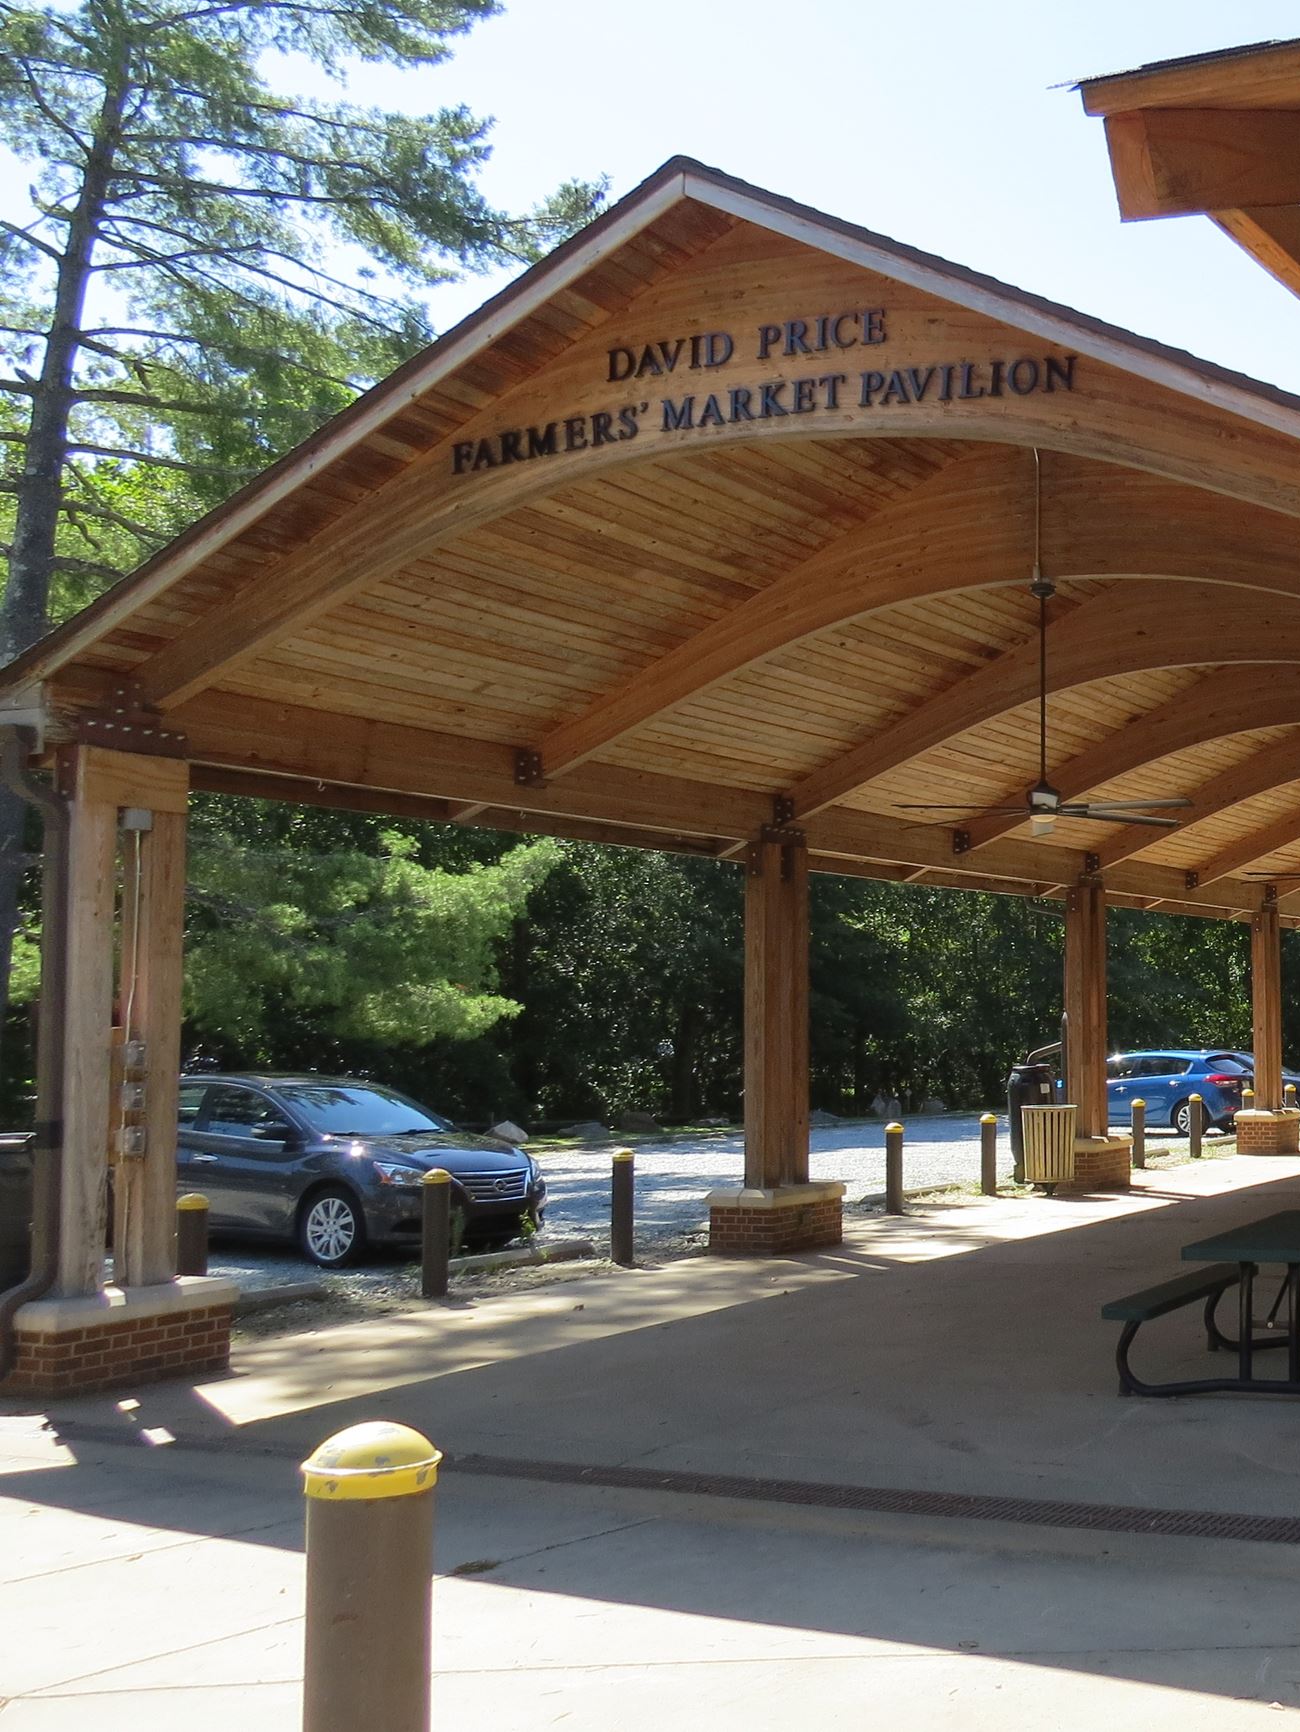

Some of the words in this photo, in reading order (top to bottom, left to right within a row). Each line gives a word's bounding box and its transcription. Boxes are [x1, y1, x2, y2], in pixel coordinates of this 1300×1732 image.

[606, 331, 734, 383] DAVID
[756, 308, 887, 359] PRICE
[451, 401, 650, 475] FARMERS'
[661, 373, 845, 432] MARKET
[857, 354, 1078, 407] PAVILION
